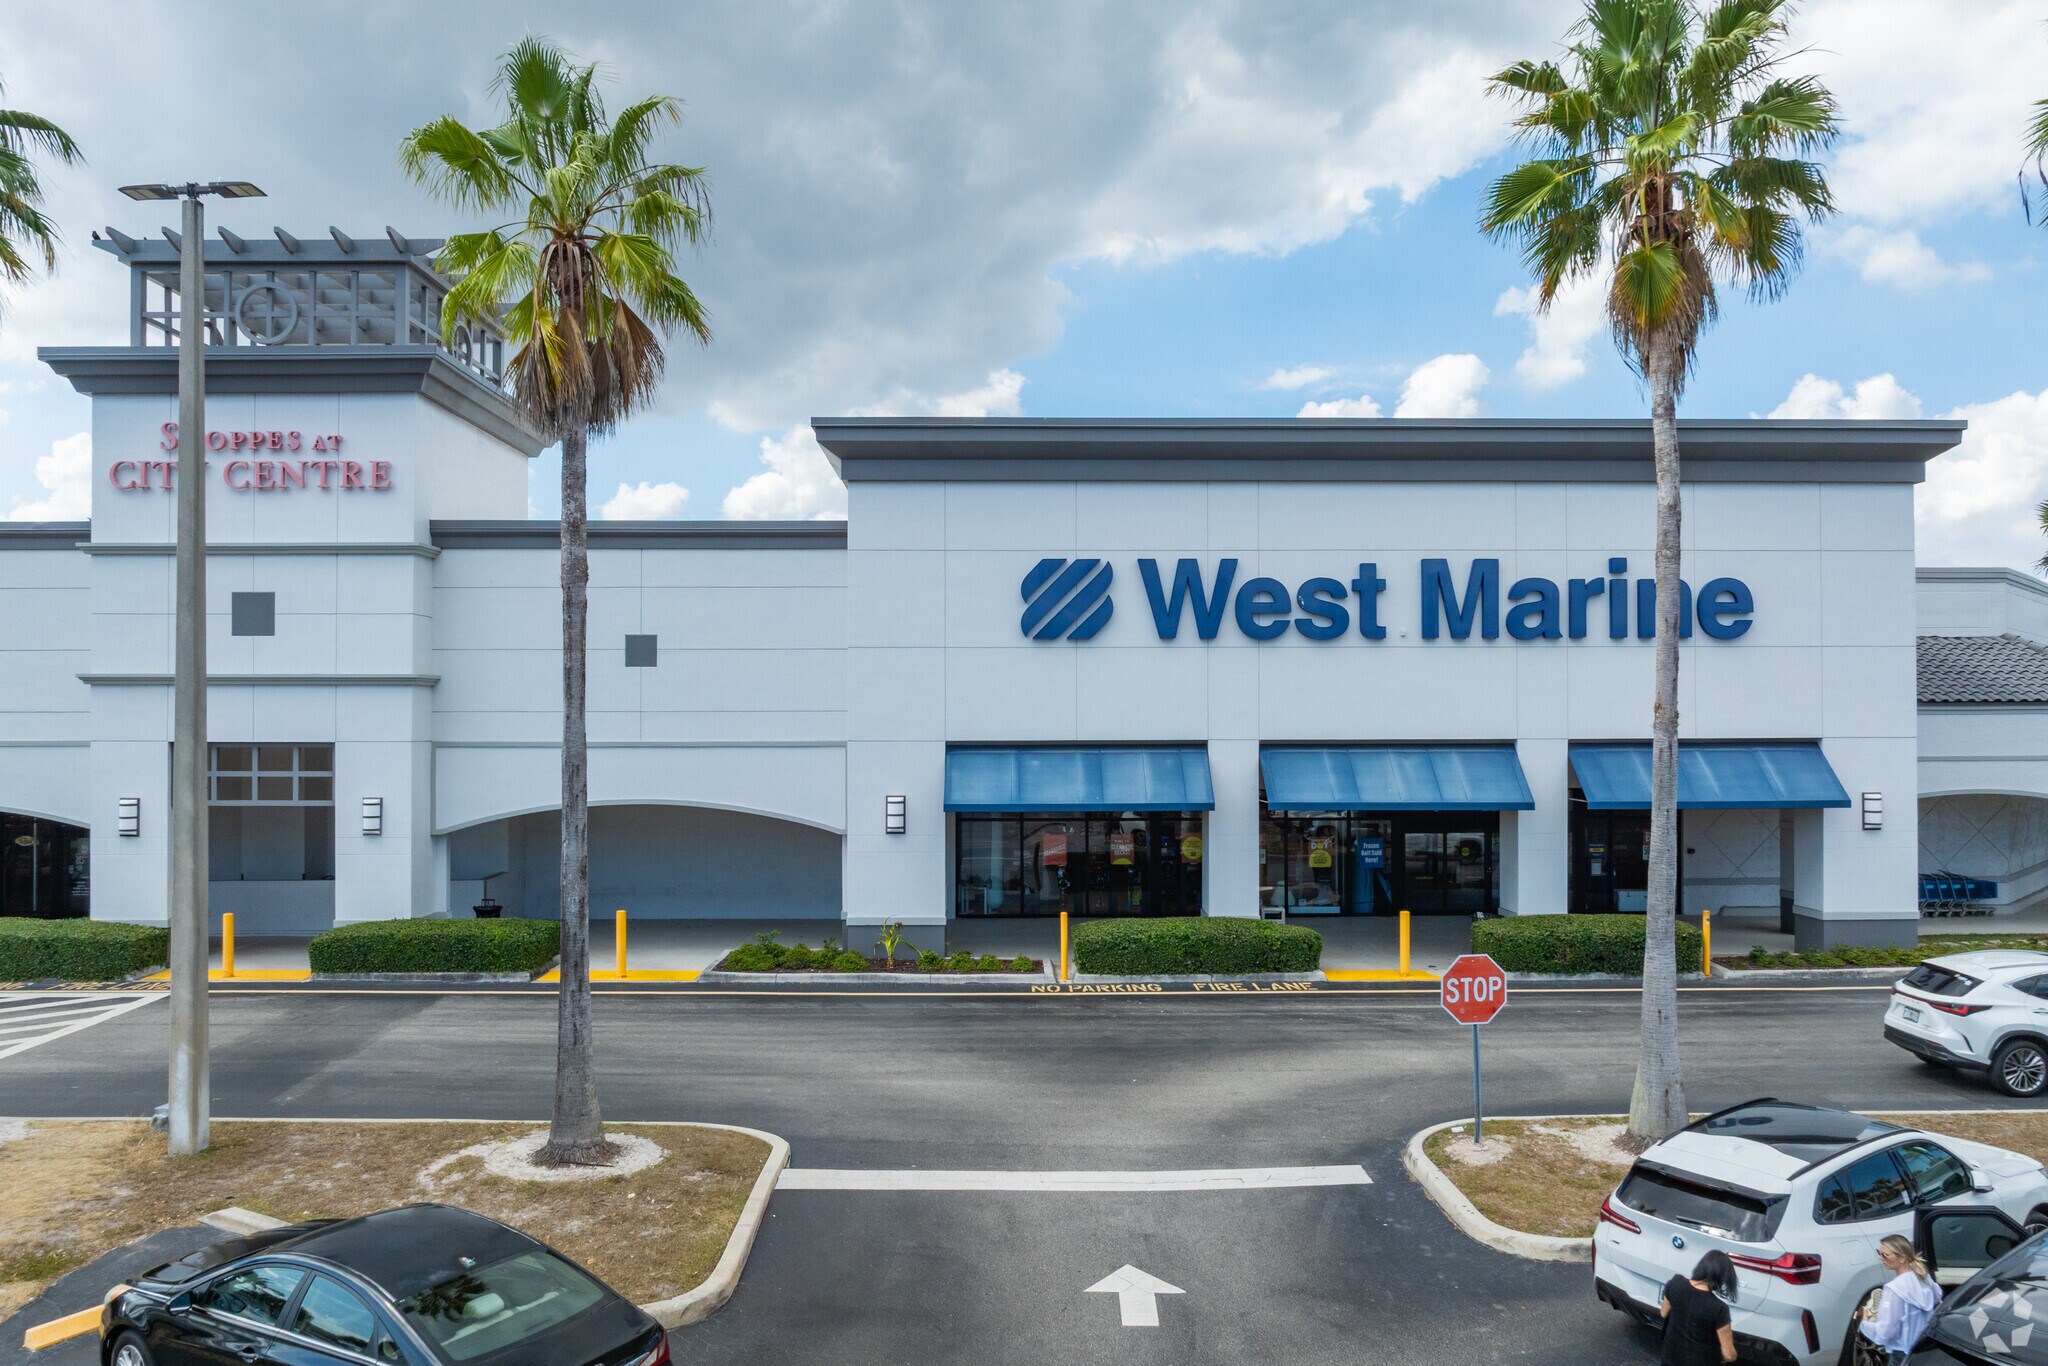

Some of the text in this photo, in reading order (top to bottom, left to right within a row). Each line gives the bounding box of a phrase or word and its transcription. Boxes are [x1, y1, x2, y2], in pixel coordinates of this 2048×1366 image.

[160, 422, 343, 451] SOPPES AT
[109, 460, 393, 490] CIT CENTRE
[1137, 557, 1755, 641] West Marine
[1031, 982, 1318, 993] NO PARKING FIRE LANE
[1446, 976, 1502, 1003] STOP
